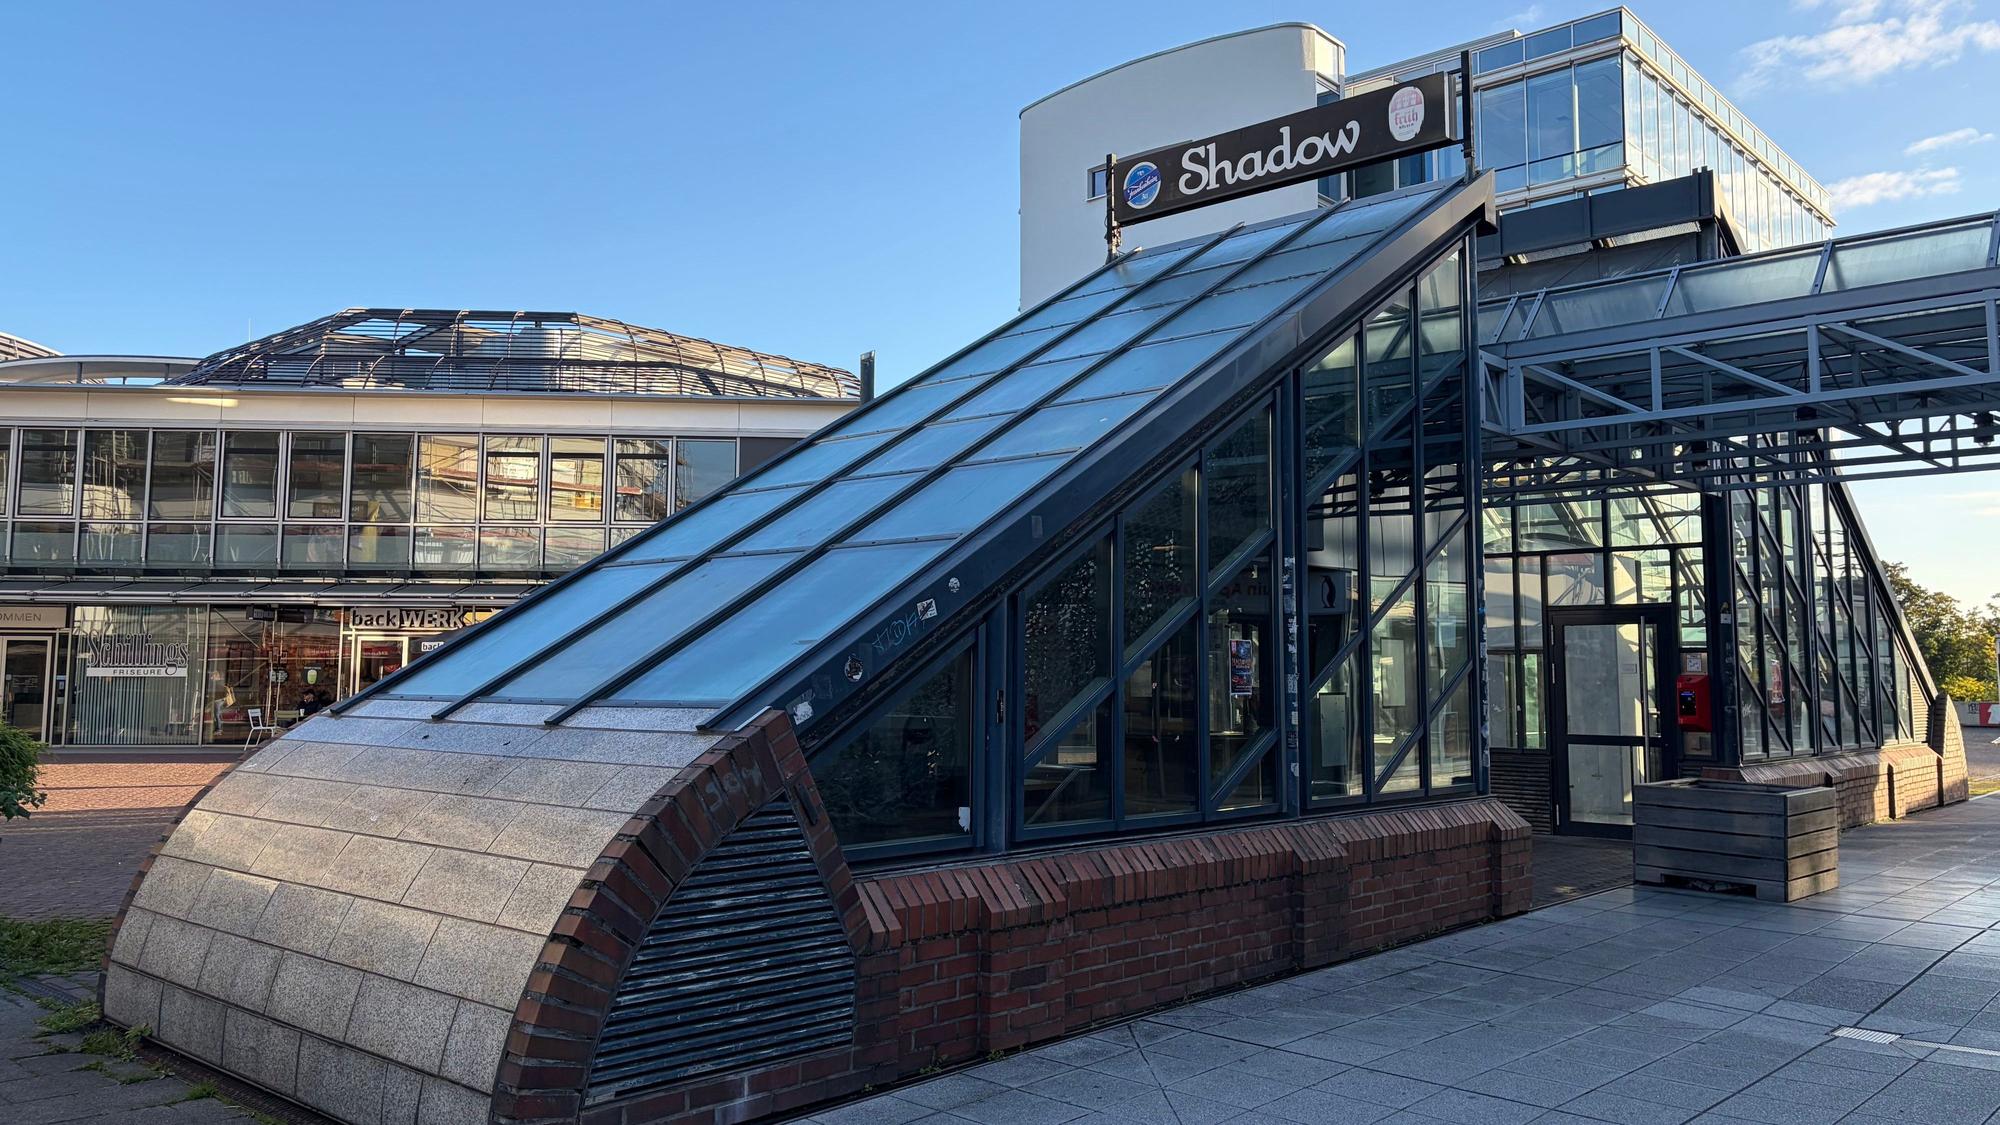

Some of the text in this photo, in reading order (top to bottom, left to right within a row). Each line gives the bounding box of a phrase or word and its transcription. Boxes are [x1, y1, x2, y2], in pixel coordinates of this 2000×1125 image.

[1179, 120, 1361, 195] Shadow
[0, 612, 42, 622] MMEN
[86, 630, 188, 675] Schillings
[112, 668, 162, 676] FRISEURE
